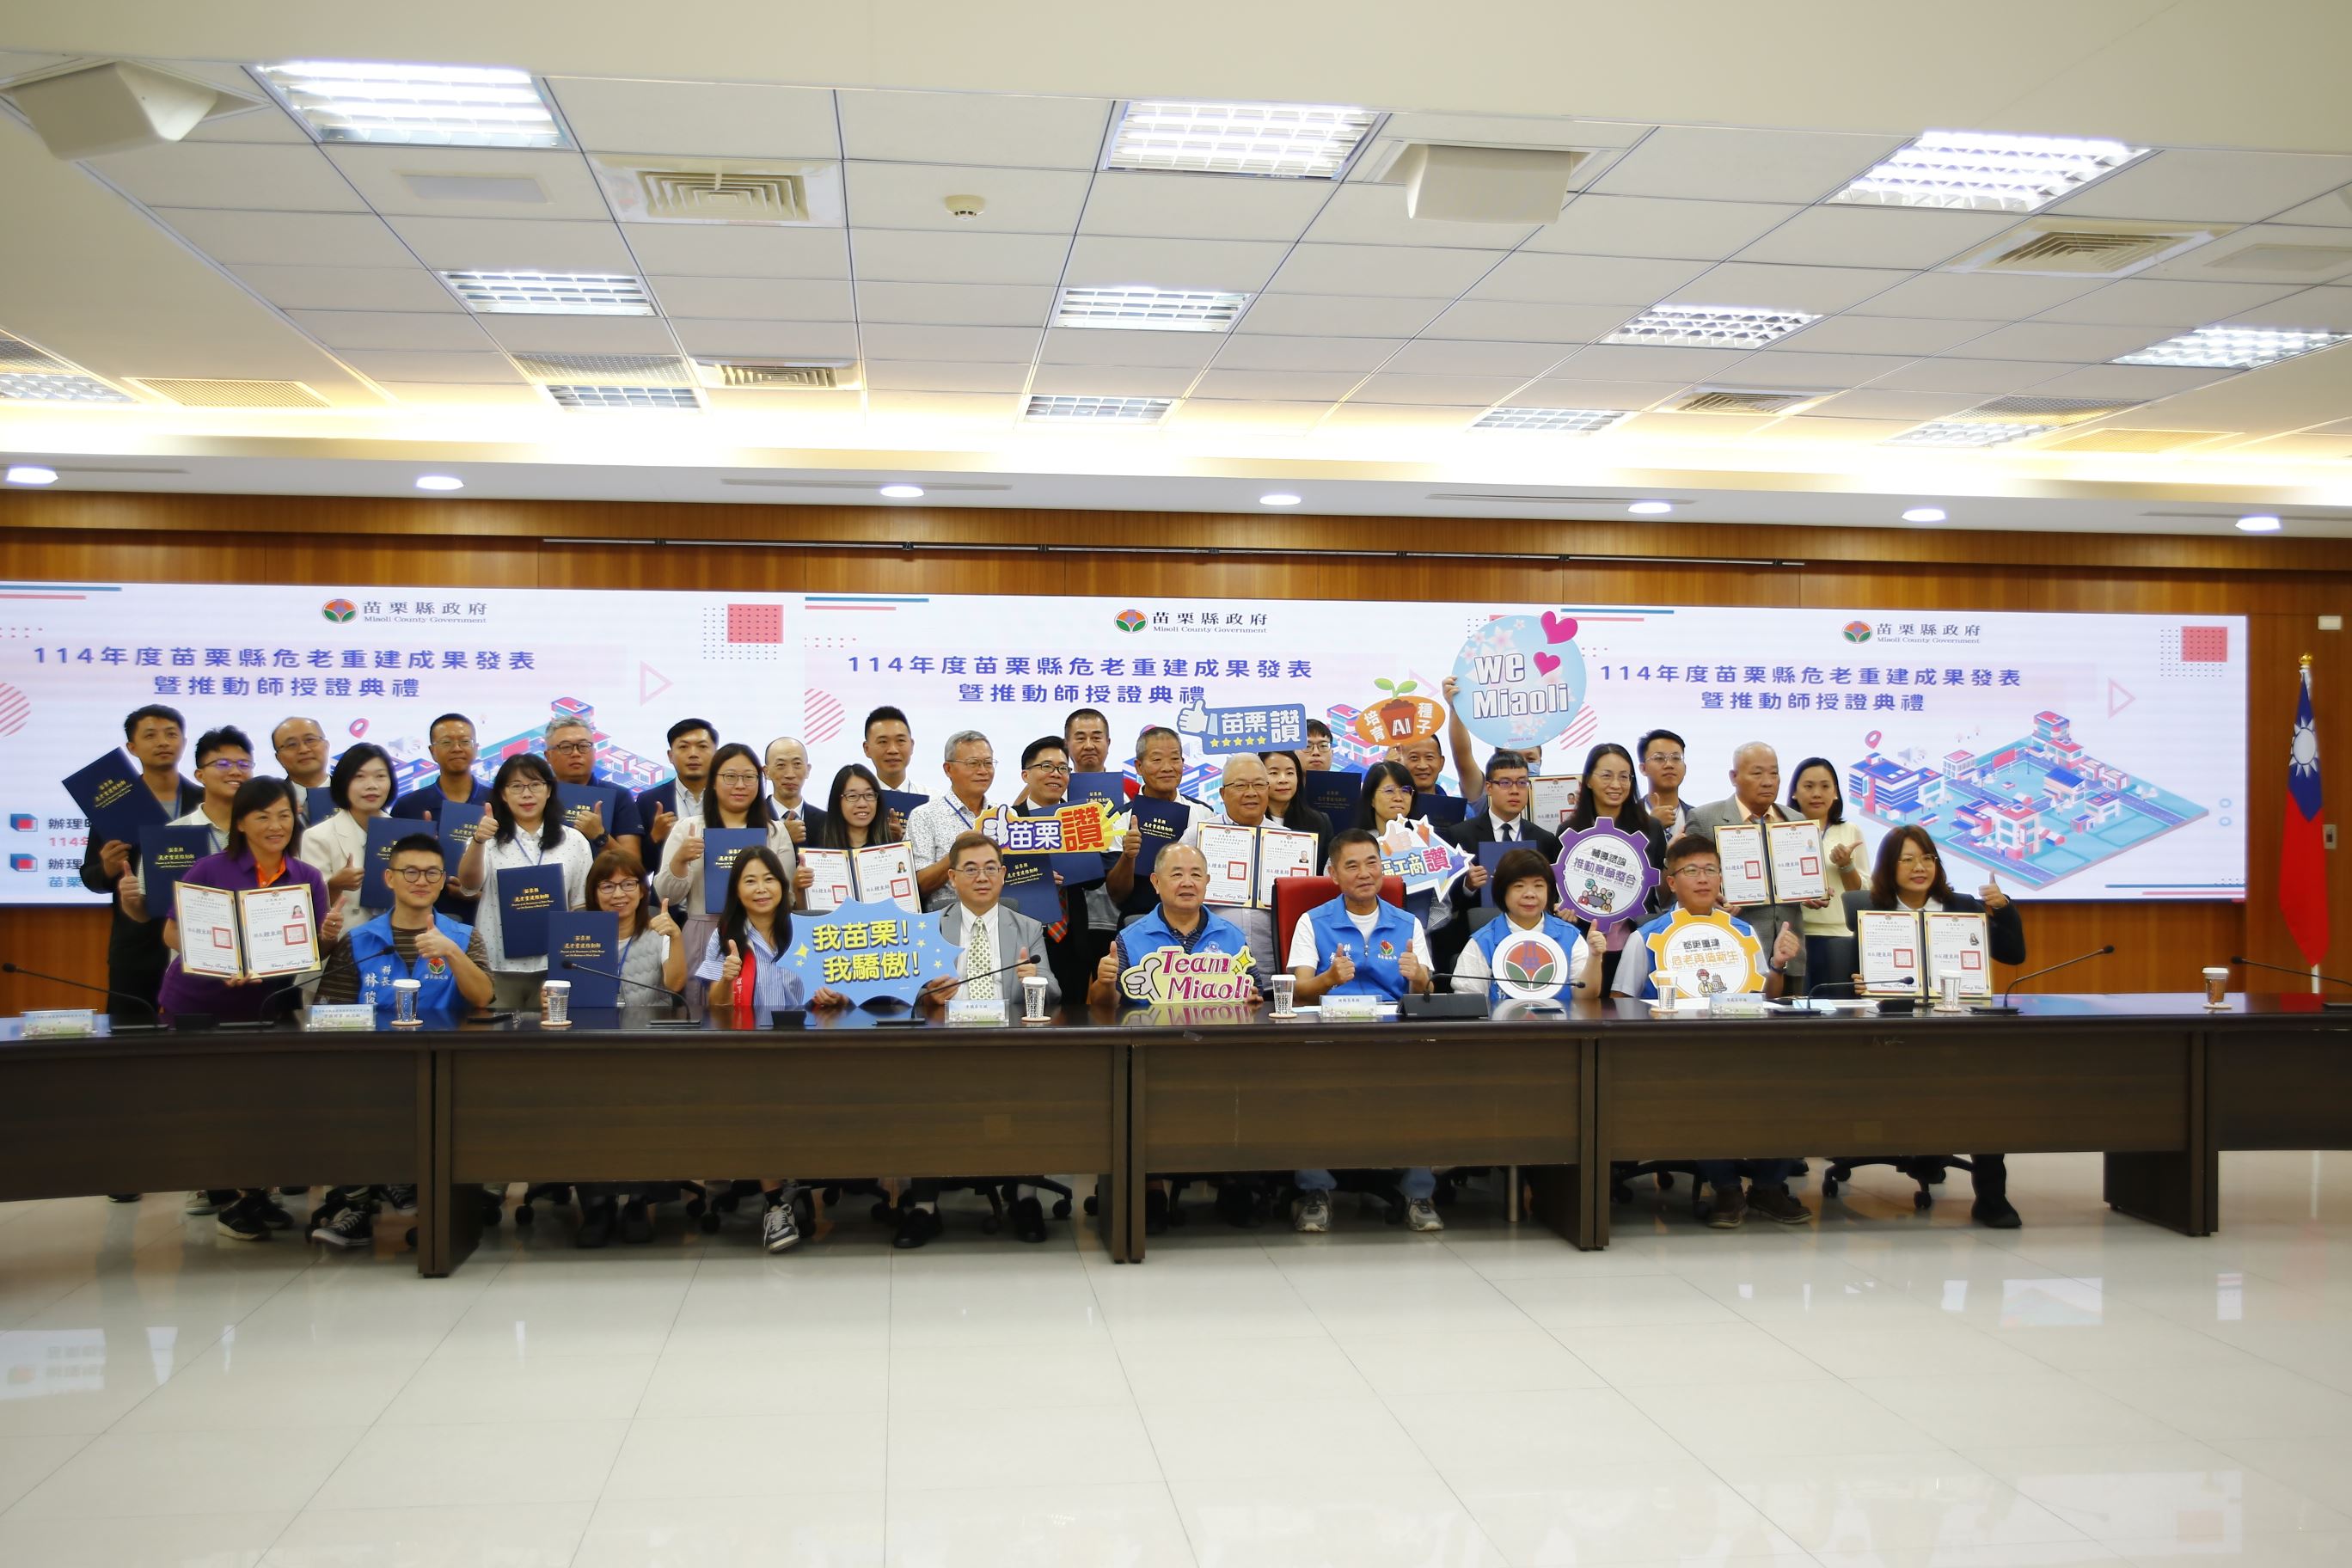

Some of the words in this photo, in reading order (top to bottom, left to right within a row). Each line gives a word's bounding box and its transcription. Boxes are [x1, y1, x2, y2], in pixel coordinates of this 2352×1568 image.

[364, 601, 487, 616] 苗栗縣政府
[394, 616, 427, 624] County
[1152, 611, 1268, 626] 苗栗縣政府
[1877, 623, 1981, 637] 苗栗縣政府
[34, 646, 536, 671] 114年度苗栗縣危老重建成果發表
[848, 655, 1312, 678] 114年度苗栗縣危老重建成果發表
[153, 675, 420, 698] 暨推動師授證典禮
[1600, 665, 2021, 687] 114年度苗栗縣危老重建成果發表
[958, 683, 1204, 705] 暨推動師授證典禮
[1473, 683, 1569, 719] Miaoli
[1700, 690, 1925, 712] 暨推動師授證典禮
[1221, 708, 1302, 744] 苗栗讚
[1363, 711, 1386, 743] 培育
[1392, 717, 1412, 737] AI
[1417, 701, 1435, 735] 種子
[1008, 805, 1105, 852] 苗栗讚
[1161, 950, 1230, 974] Team
[1167, 976, 1252, 1000] Miaoli
